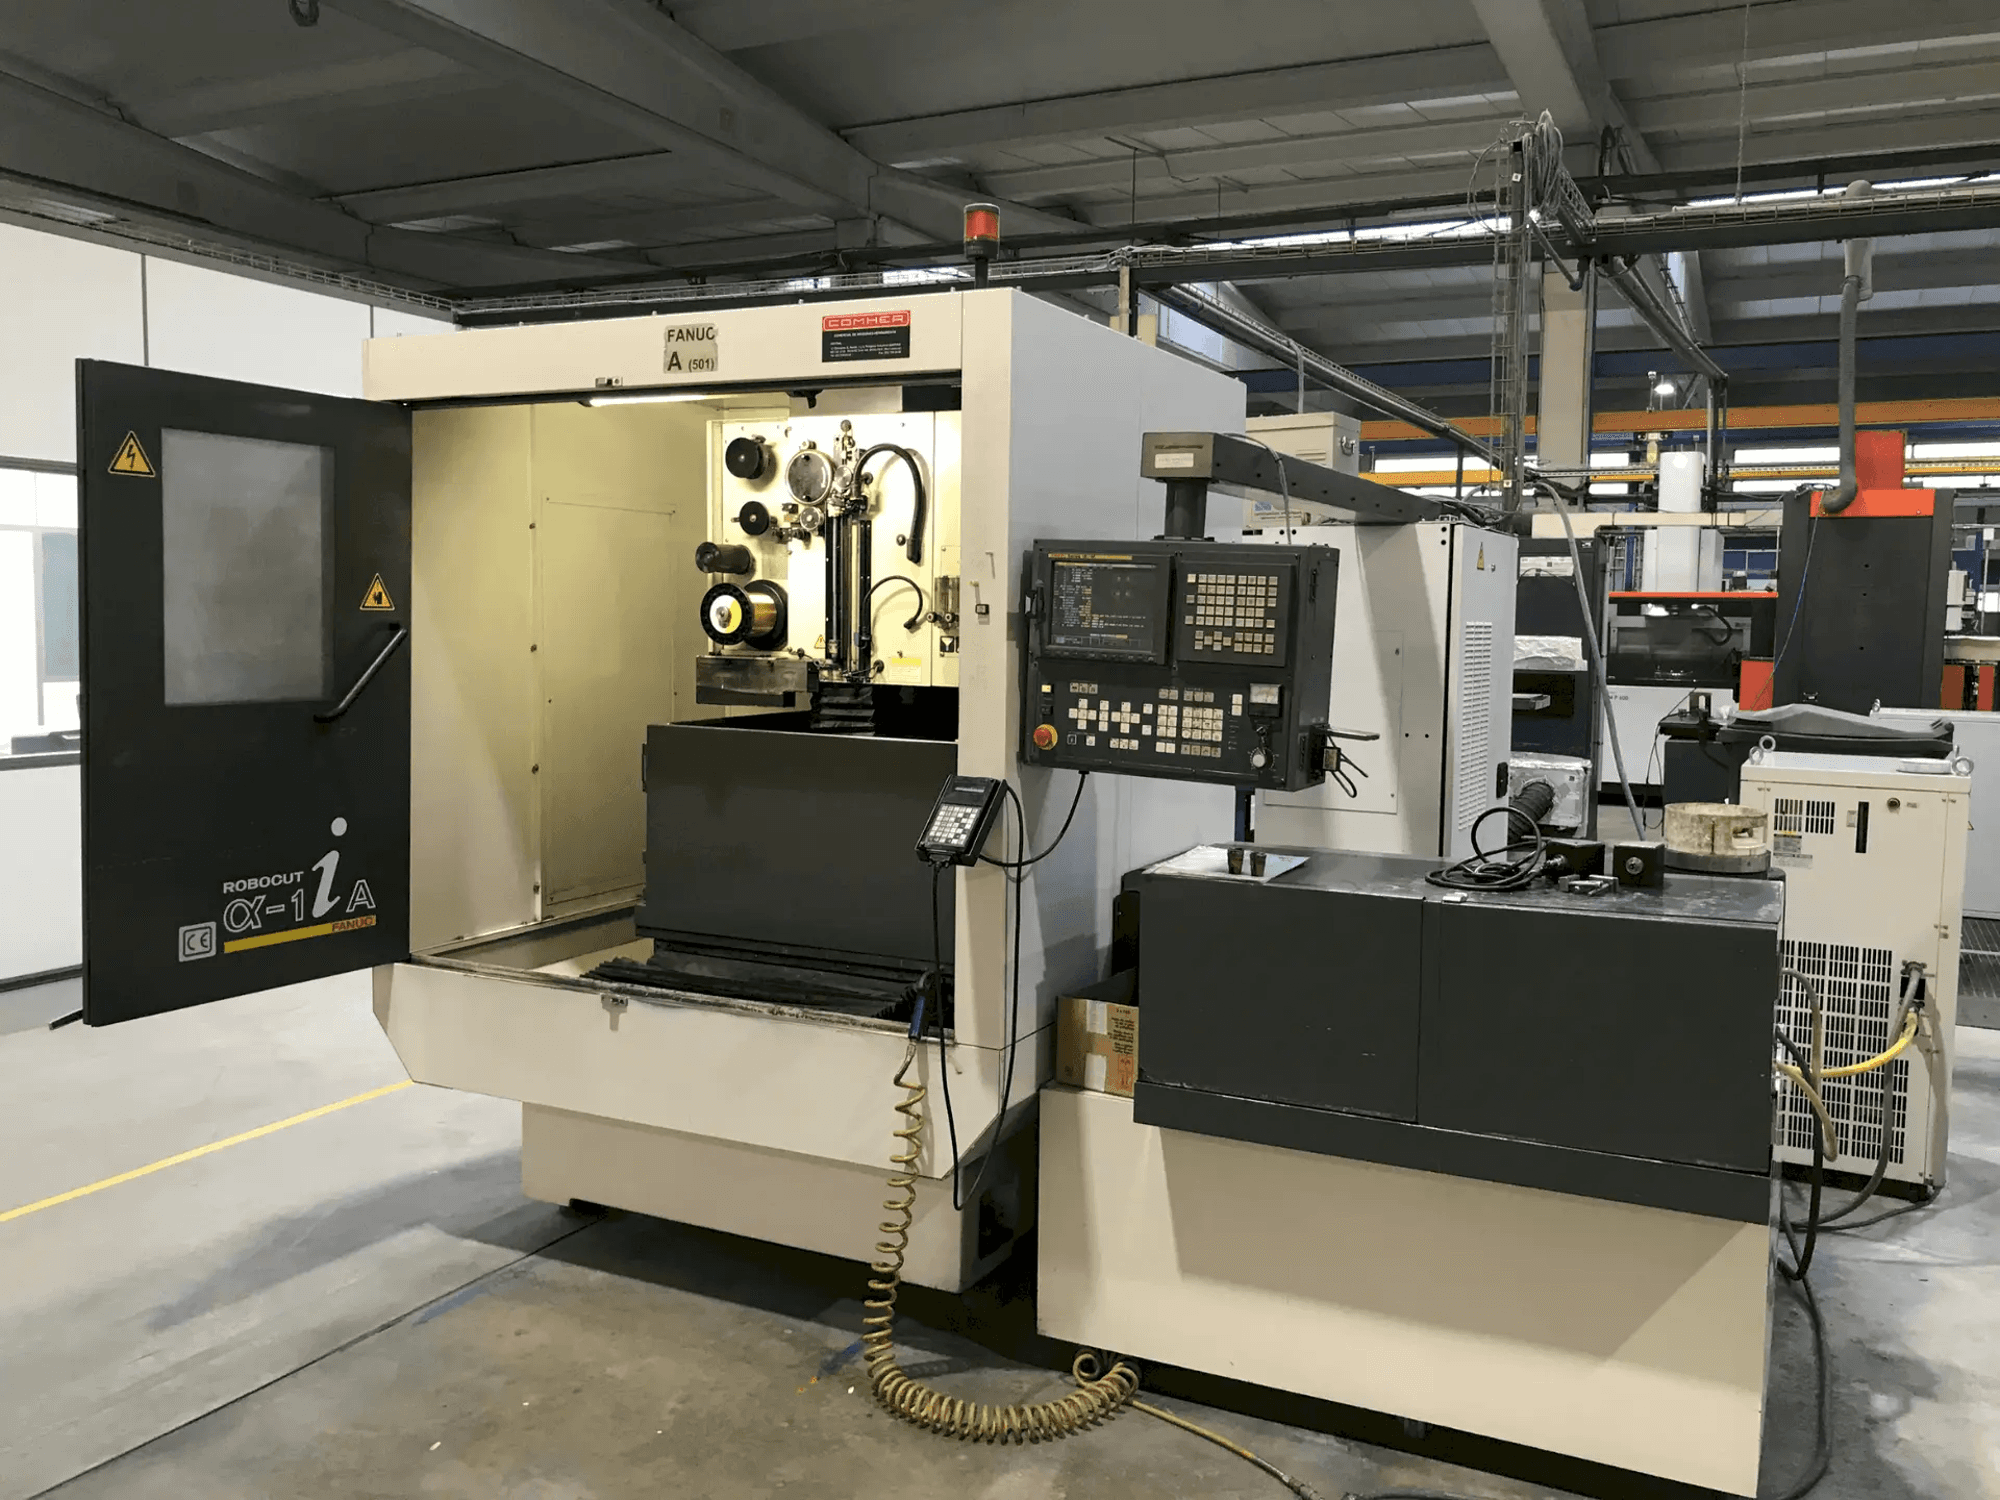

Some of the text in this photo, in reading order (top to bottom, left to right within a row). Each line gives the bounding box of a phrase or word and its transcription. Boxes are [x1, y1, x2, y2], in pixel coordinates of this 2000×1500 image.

[828, 314, 904, 328] COMHER
[667, 326, 715, 342] FANUC
[667, 351, 715, 372] A (501)
[223, 871, 304, 894] ROBOCUT
[331, 916, 374, 932] FANUC
[187, 932, 208, 951] CE
